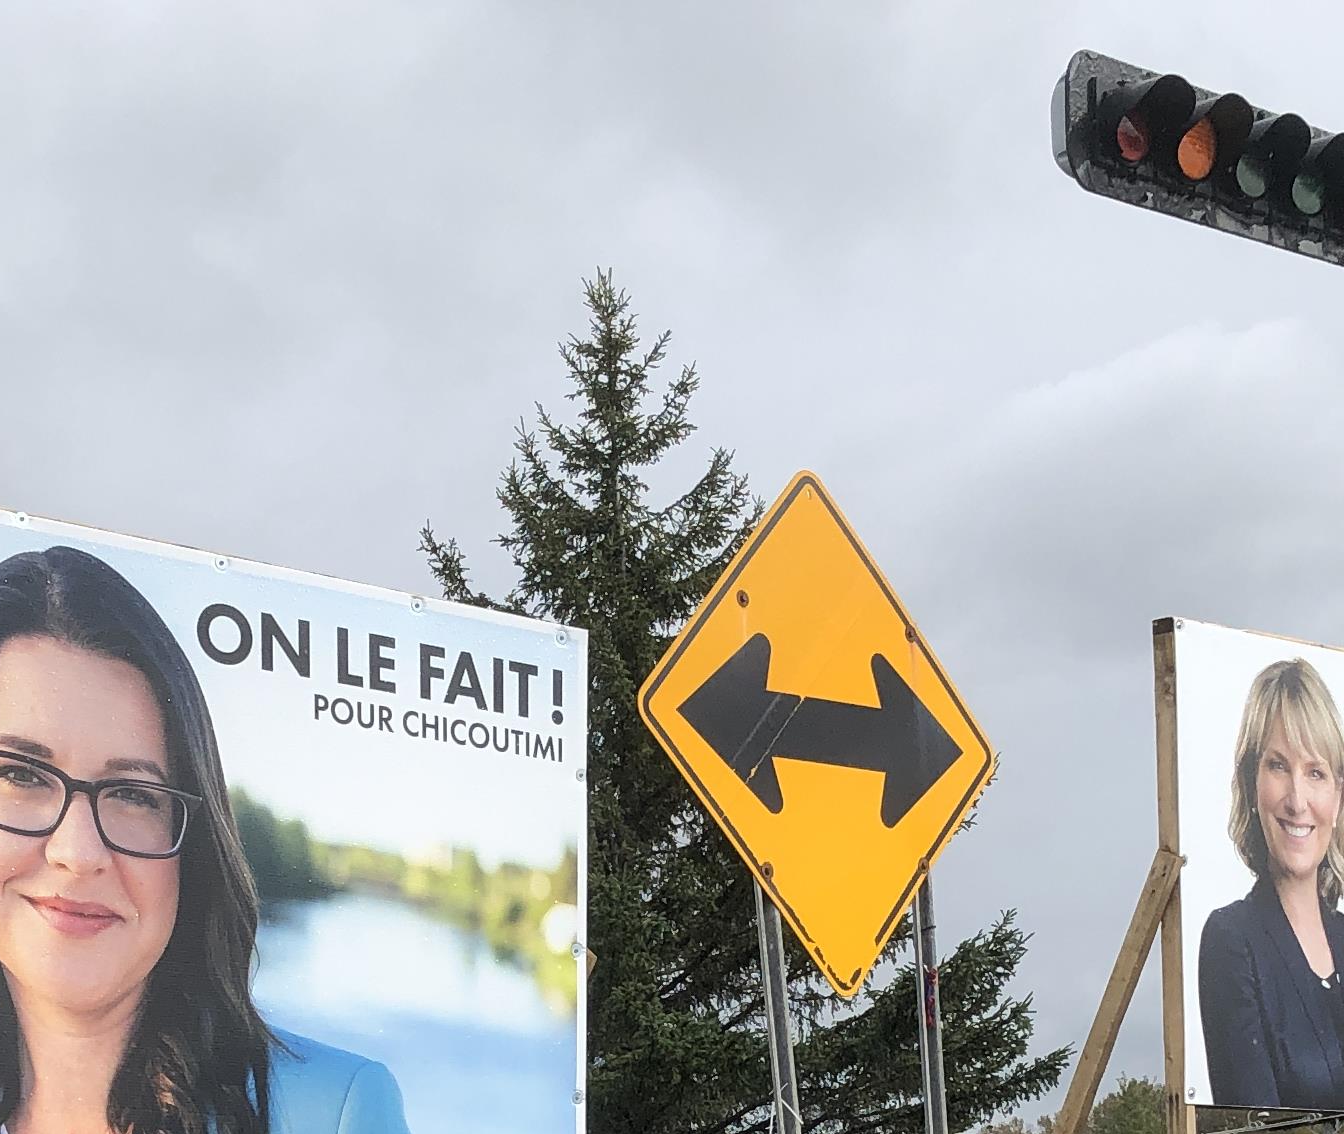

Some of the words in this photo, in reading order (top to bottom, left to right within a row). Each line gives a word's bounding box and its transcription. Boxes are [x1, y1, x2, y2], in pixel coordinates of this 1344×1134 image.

[196, 603, 310, 678] ON
[337, 627, 397, 694] LE
[314, 694, 394, 733] POUR
[402, 711, 564, 763] CHICOUTIMI
